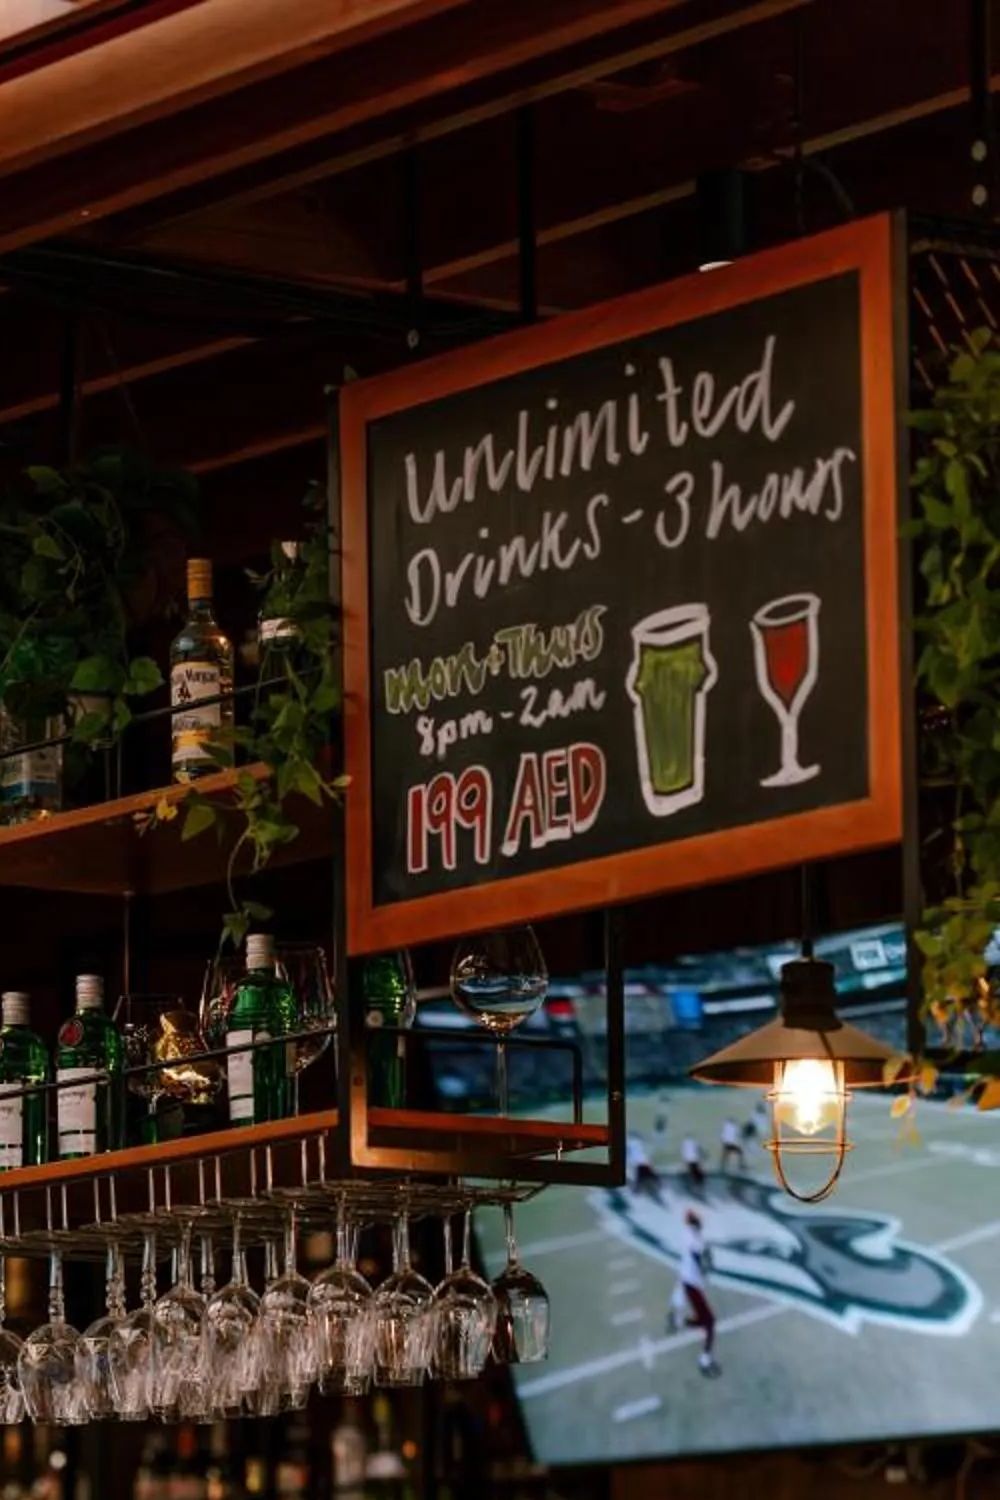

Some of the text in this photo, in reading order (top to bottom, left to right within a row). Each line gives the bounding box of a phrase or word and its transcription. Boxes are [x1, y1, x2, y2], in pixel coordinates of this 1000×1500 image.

[654, 470, 695, 549] 3
[705, 447, 856, 540] hours
[407, 742, 606, 873] 199 AED
